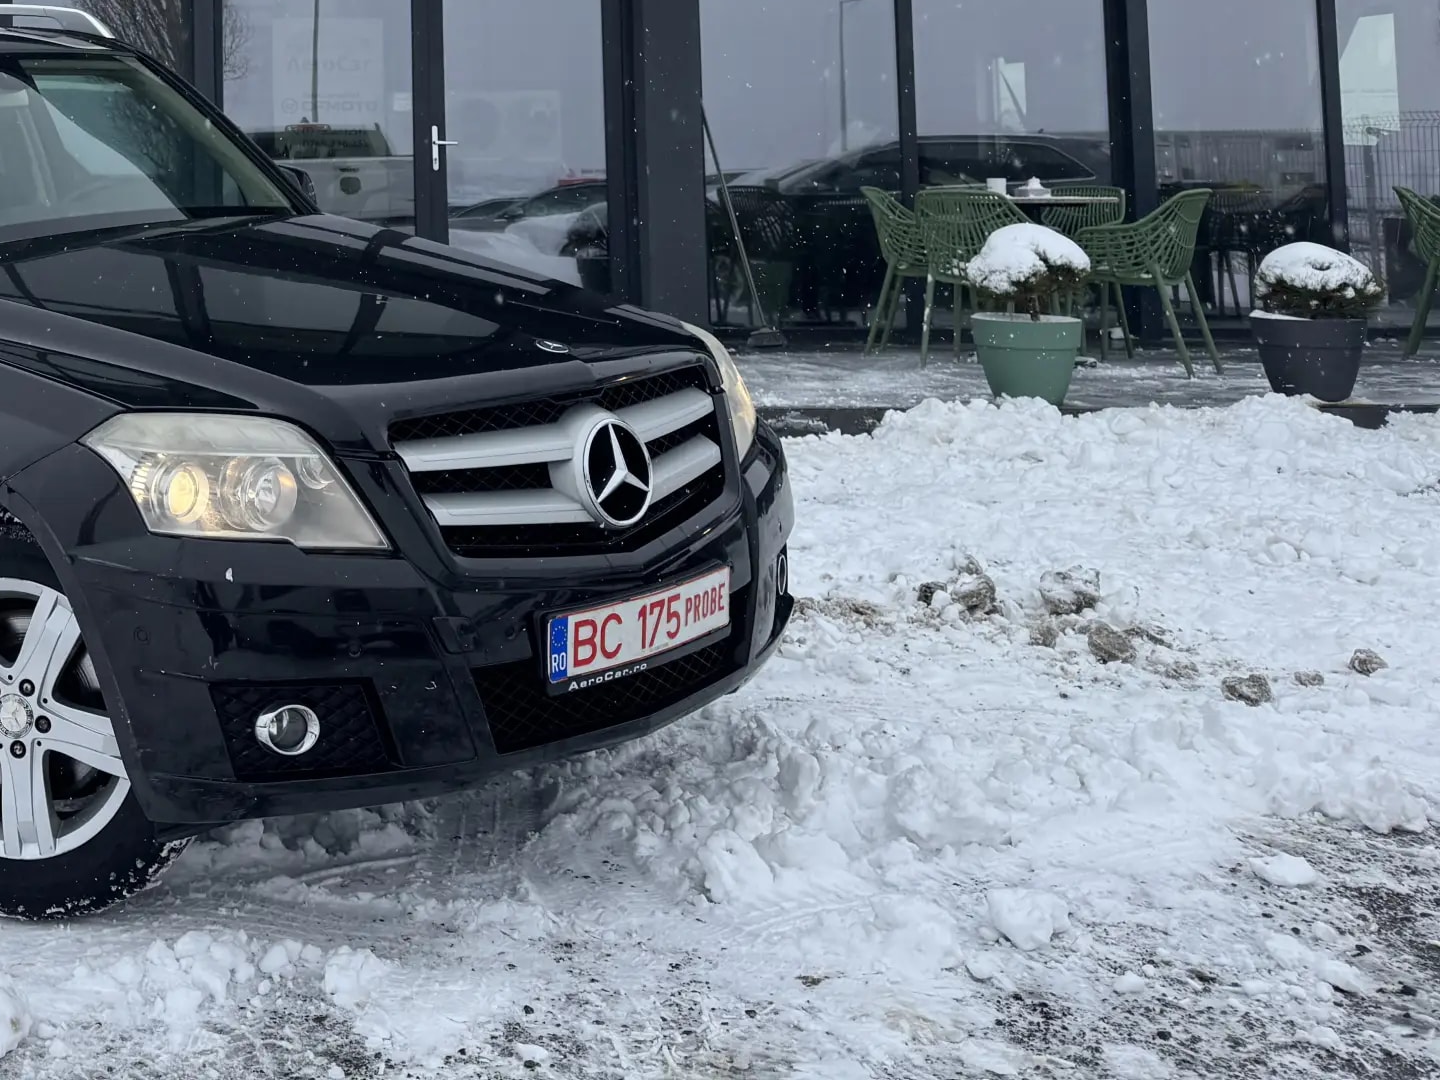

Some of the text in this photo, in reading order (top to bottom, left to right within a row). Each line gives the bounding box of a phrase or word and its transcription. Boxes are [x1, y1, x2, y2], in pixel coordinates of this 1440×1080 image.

[287, 56, 373, 72] AeoCar
[573, 583, 726, 668] BC 175 PROBE
[551, 652, 567, 674] RO
[568, 662, 648, 691] AeroCar.ro
